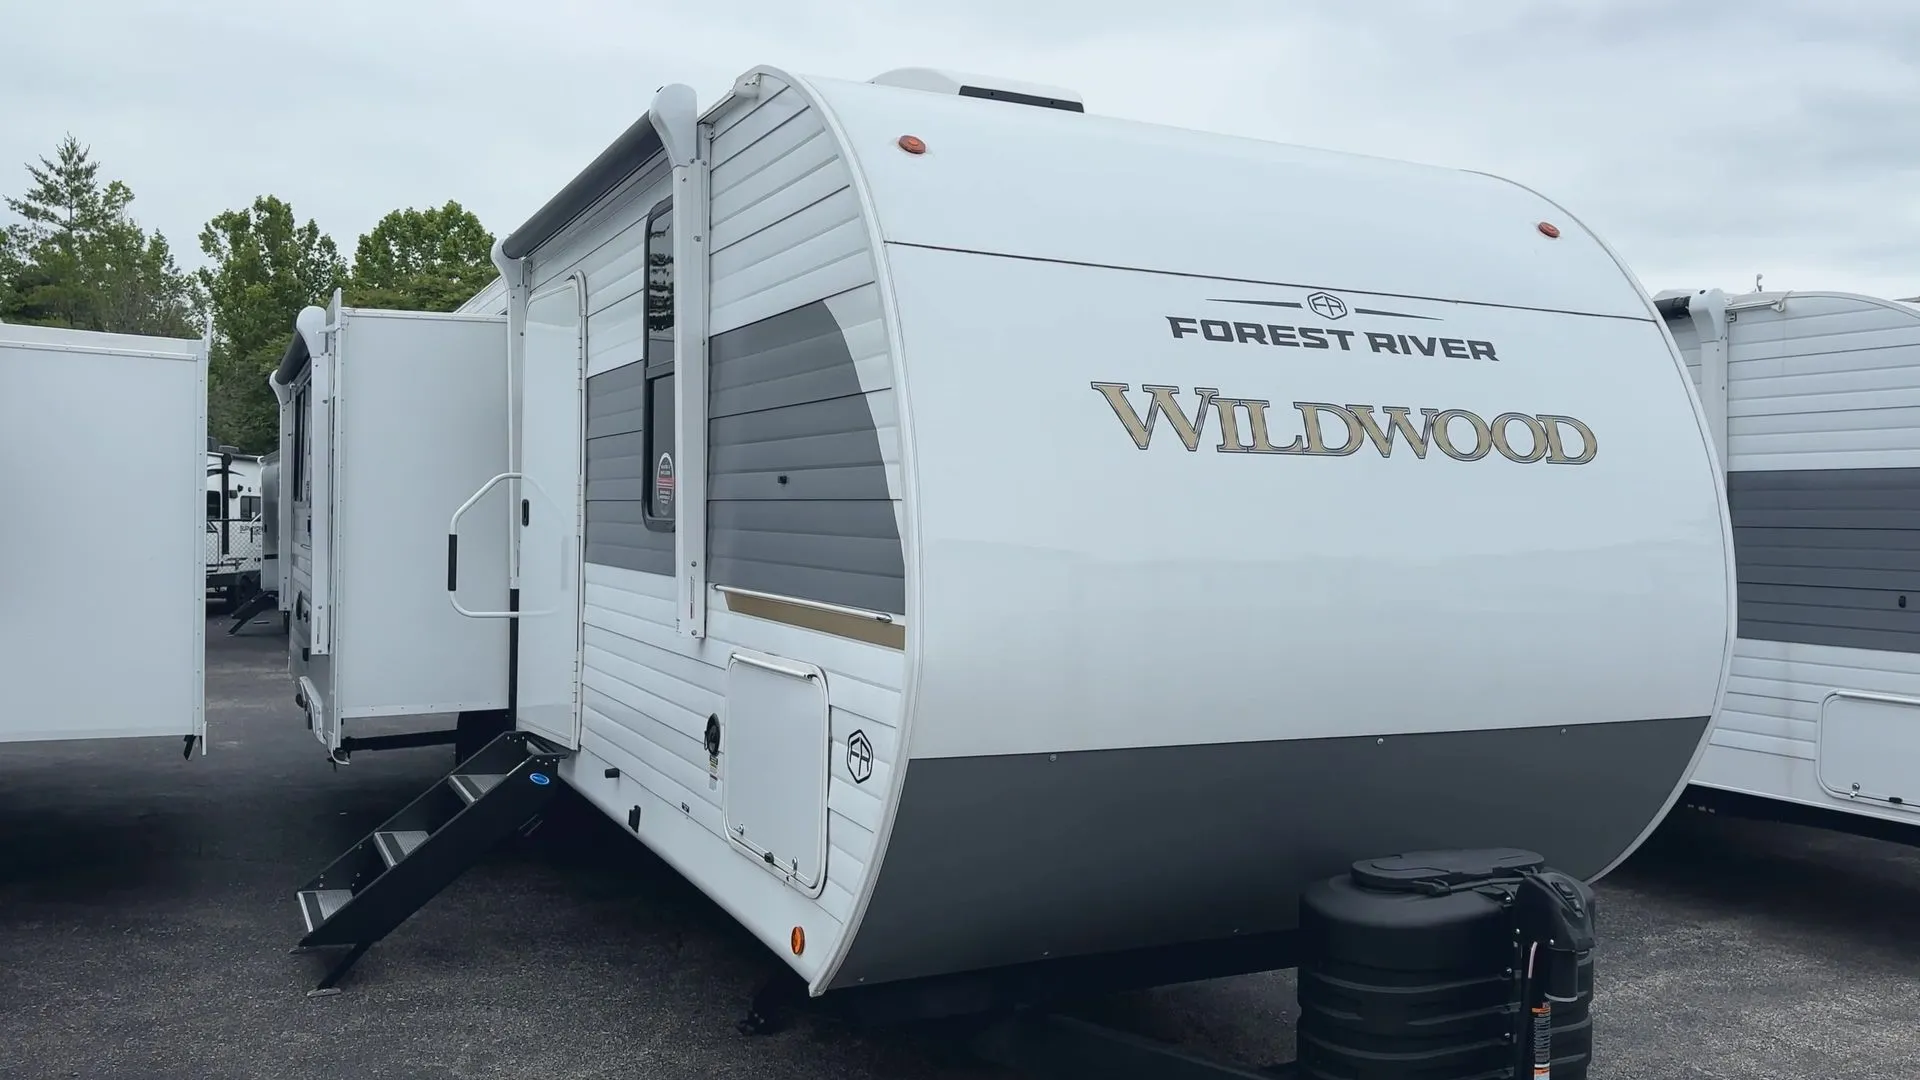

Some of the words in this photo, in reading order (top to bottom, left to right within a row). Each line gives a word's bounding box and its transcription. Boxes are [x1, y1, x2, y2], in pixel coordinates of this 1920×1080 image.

[1165, 316, 1355, 352] FOREST
[1363, 332, 1500, 362] RIVER
[1090, 381, 1598, 466] WILDWOOD
